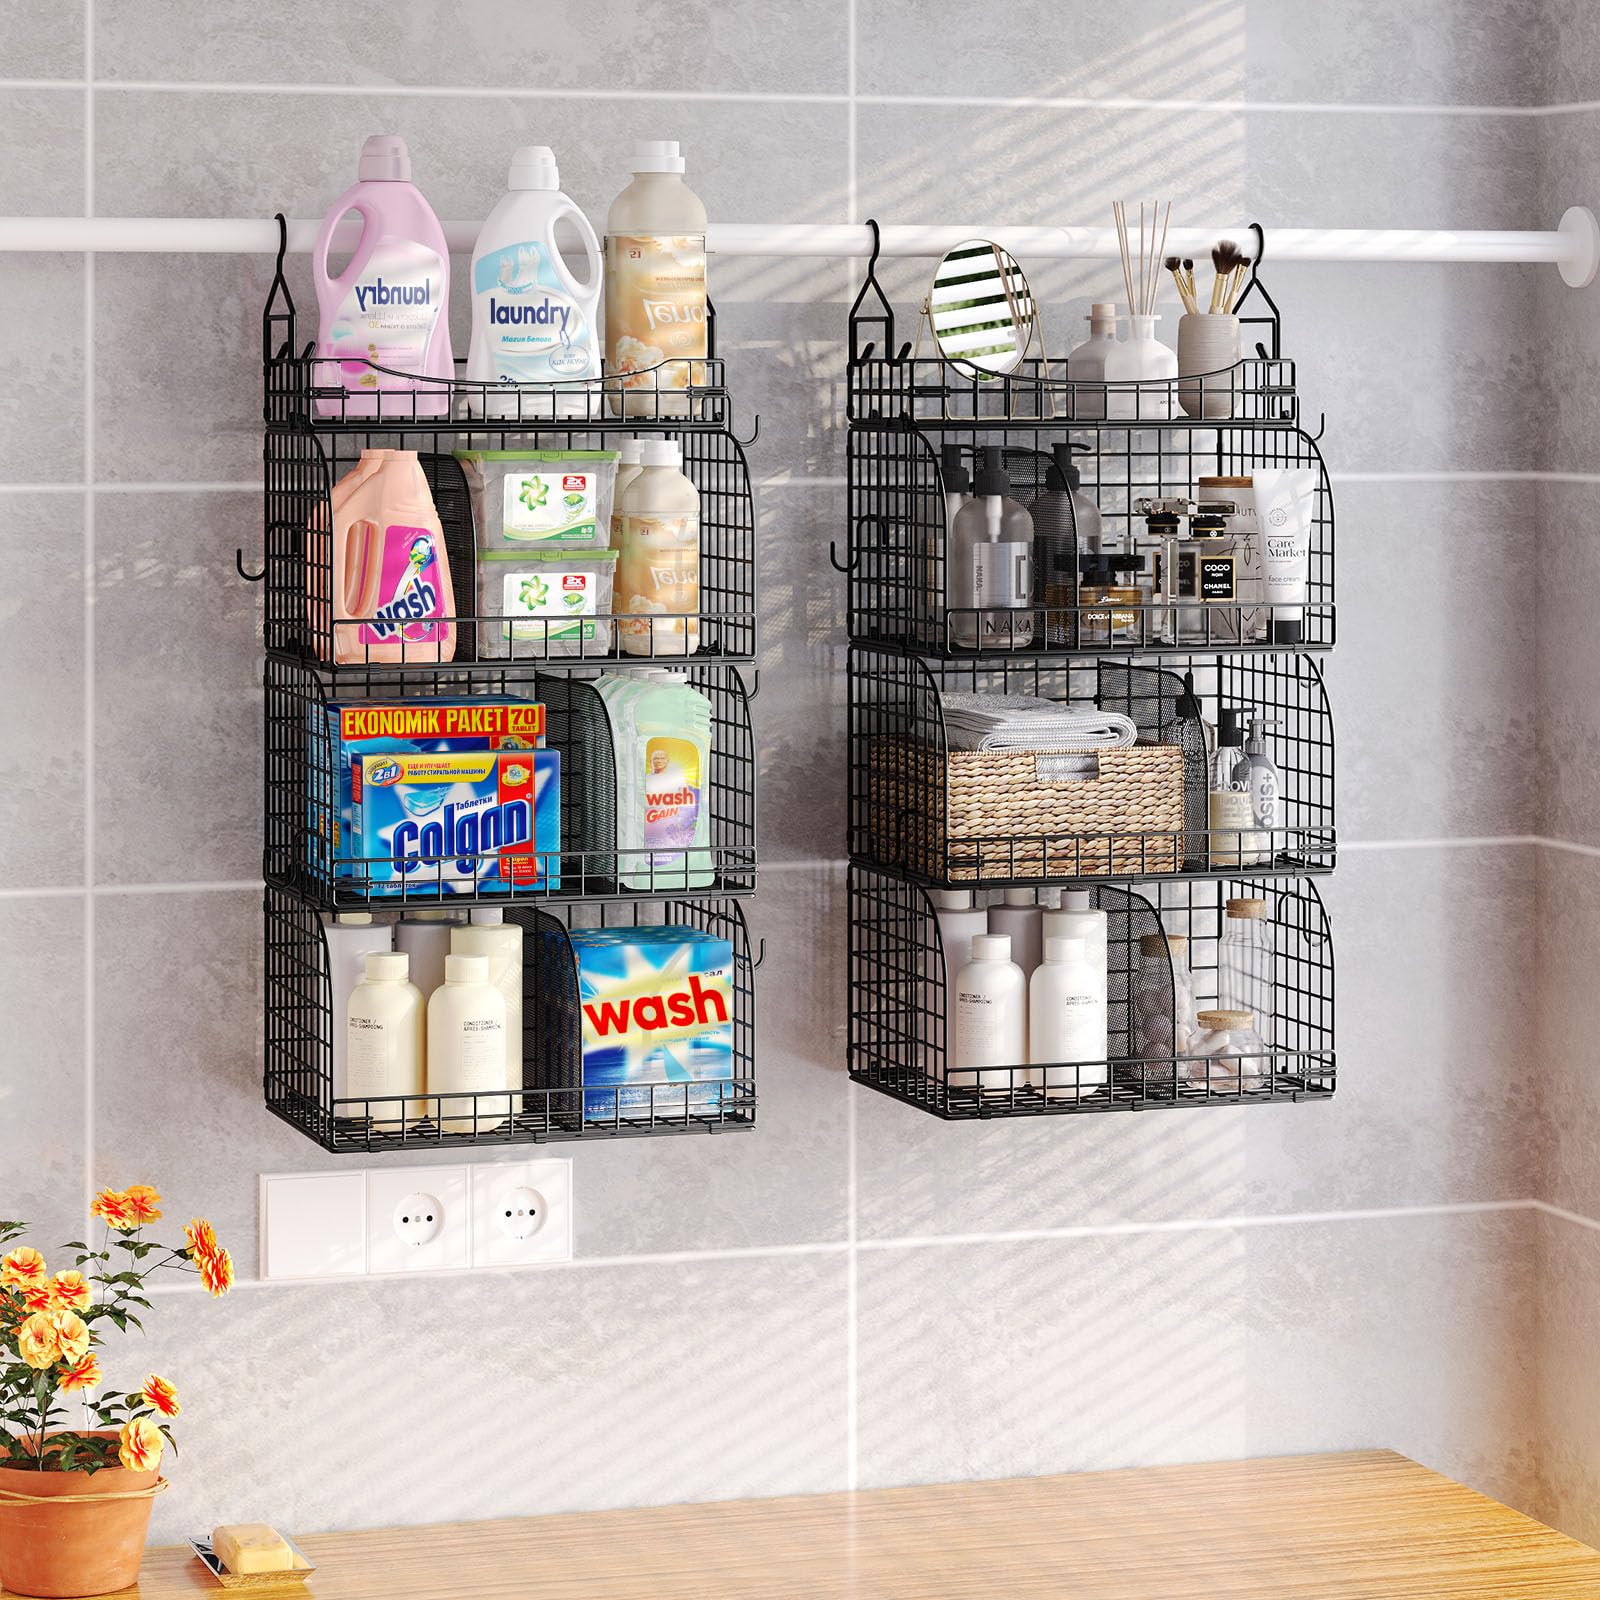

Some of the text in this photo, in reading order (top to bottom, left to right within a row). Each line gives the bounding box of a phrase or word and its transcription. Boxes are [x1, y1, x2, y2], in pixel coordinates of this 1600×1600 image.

[490, 297, 571, 332] laundry
[1267, 539, 1295, 549] Care
[1268, 549, 1306, 558] Market
[1204, 564, 1230, 572] COCO
[370, 577, 436, 638] wash
[446, 708, 504, 732] PAKET
[511, 708, 536, 725] 70
[456, 796, 493, 811] Таблетки
[646, 787, 694, 806] wash
[646, 807, 679, 823] GAIN
[582, 975, 728, 1037] wash
